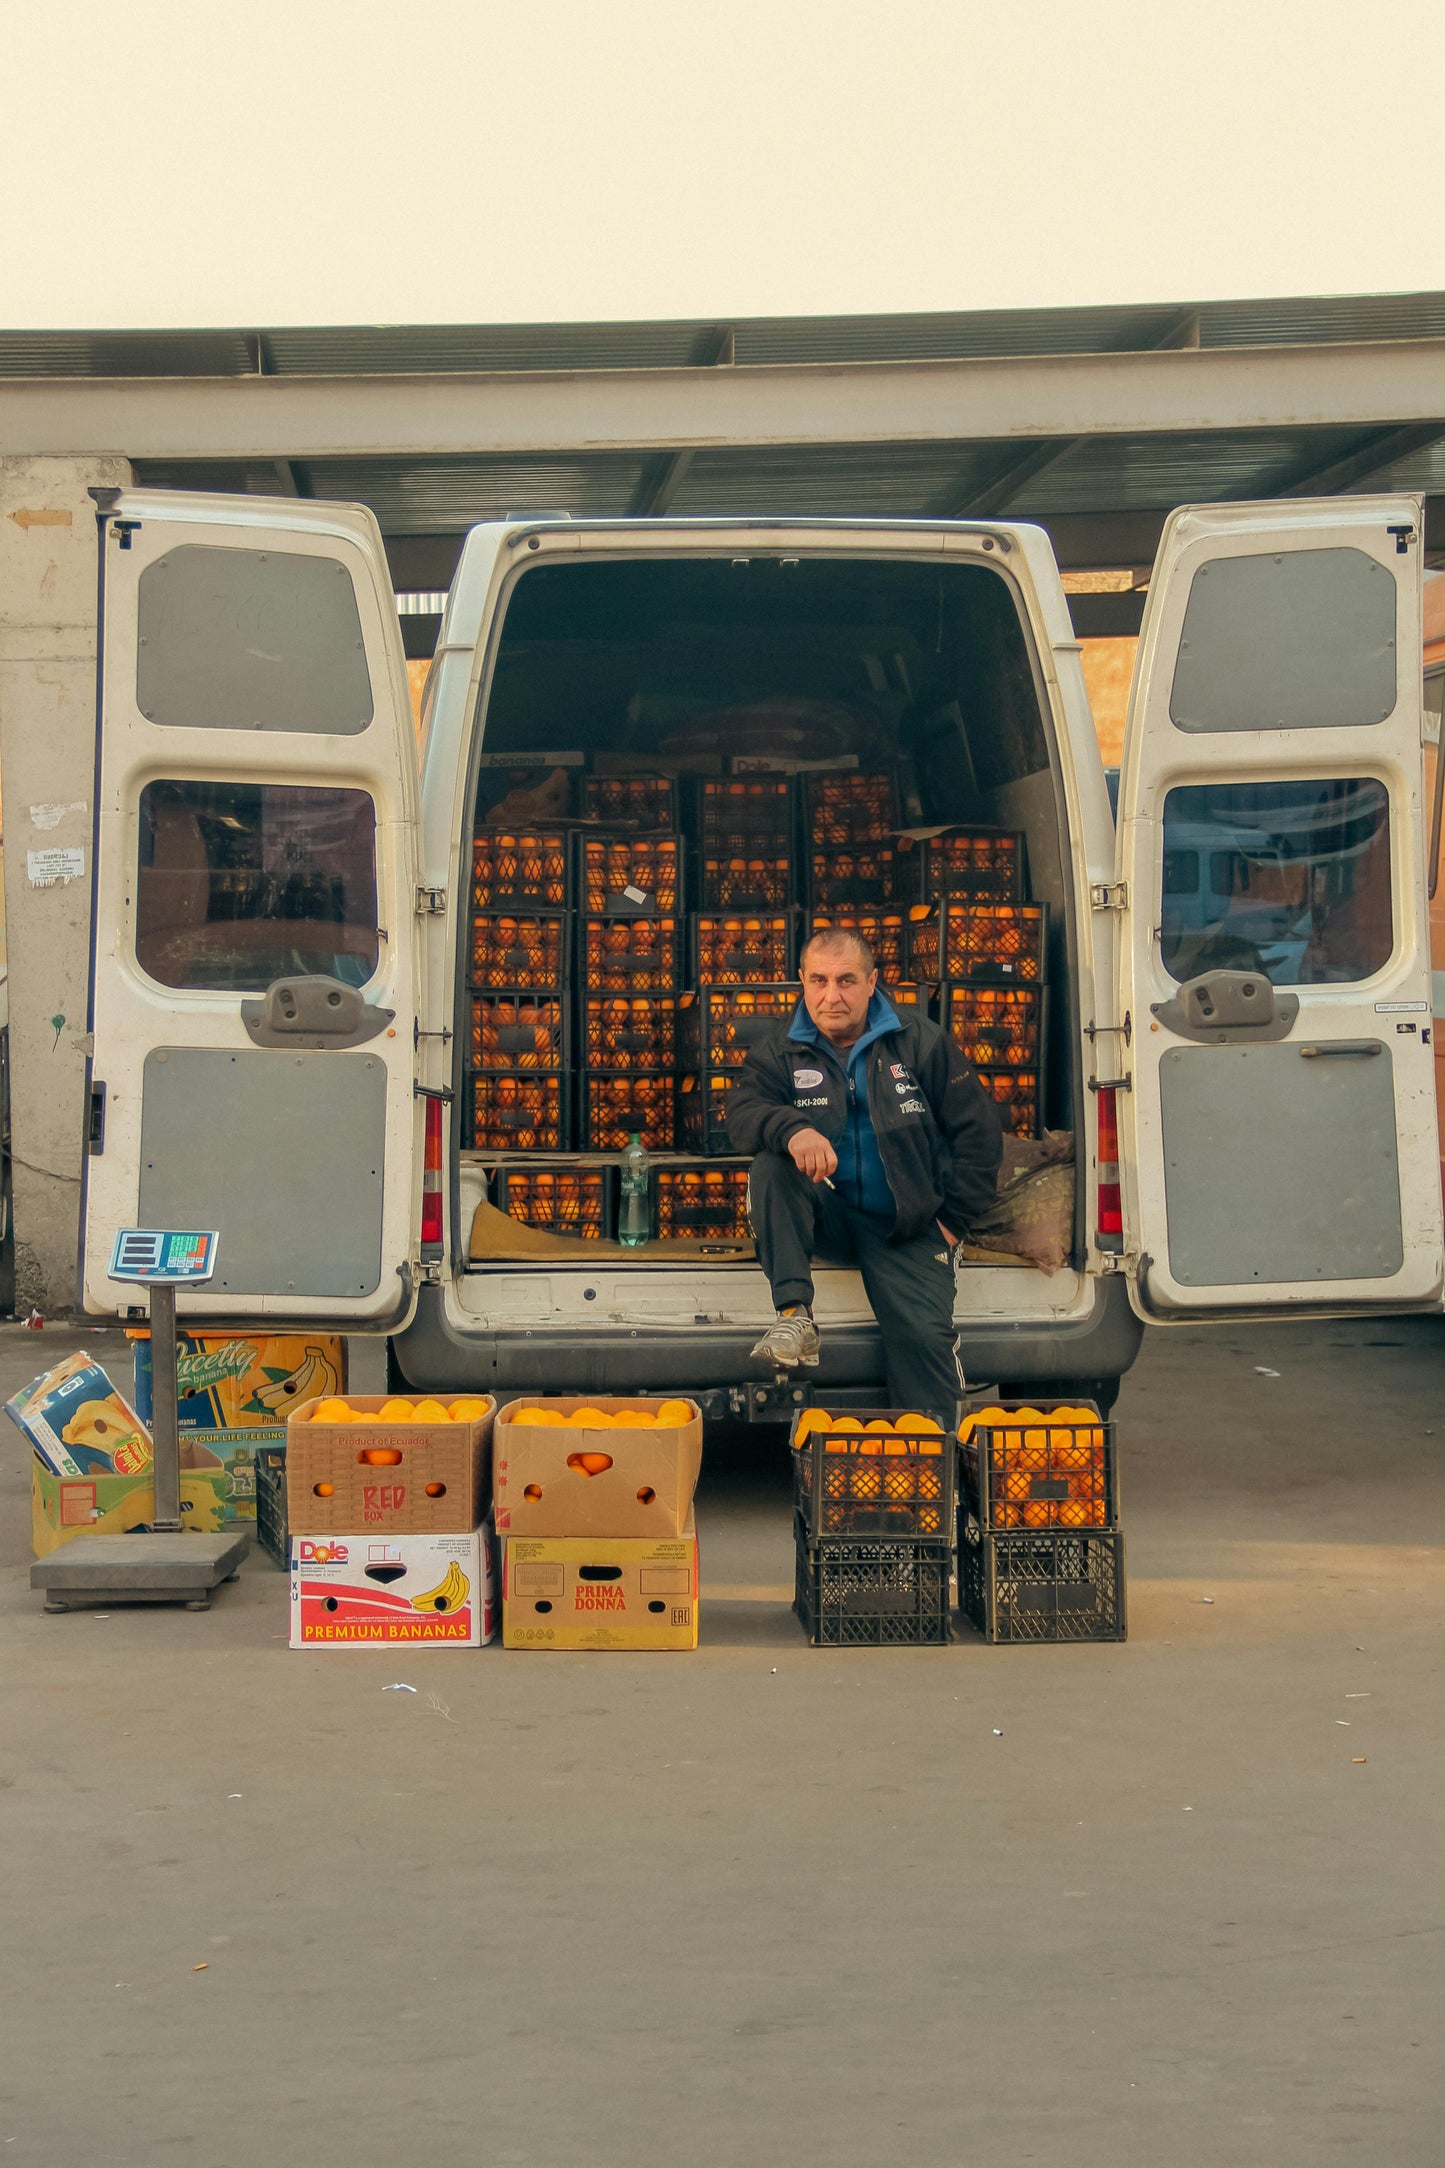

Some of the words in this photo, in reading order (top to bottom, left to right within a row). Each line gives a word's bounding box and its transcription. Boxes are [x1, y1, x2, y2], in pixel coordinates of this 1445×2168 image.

[737, 760, 771, 771] Dole
[192, 1367, 228, 1383] banana
[193, 1434, 220, 1443] YOUR
[222, 1433, 243, 1442] LIFE
[245, 1431, 285, 1441] FEELING
[338, 1436, 375, 1446] Product
[377, 1436, 388, 1446] of
[390, 1436, 431, 1446] Ecuador
[363, 1485, 406, 1511] RED
[364, 1511, 384, 1522] BOX
[300, 1541, 349, 1562] Dole
[575, 1585, 625, 1598] PRIMA
[575, 1597, 627, 1610] DONNA
[305, 1624, 383, 1639] PREMIUM
[388, 1623, 468, 1638] BANANAS
